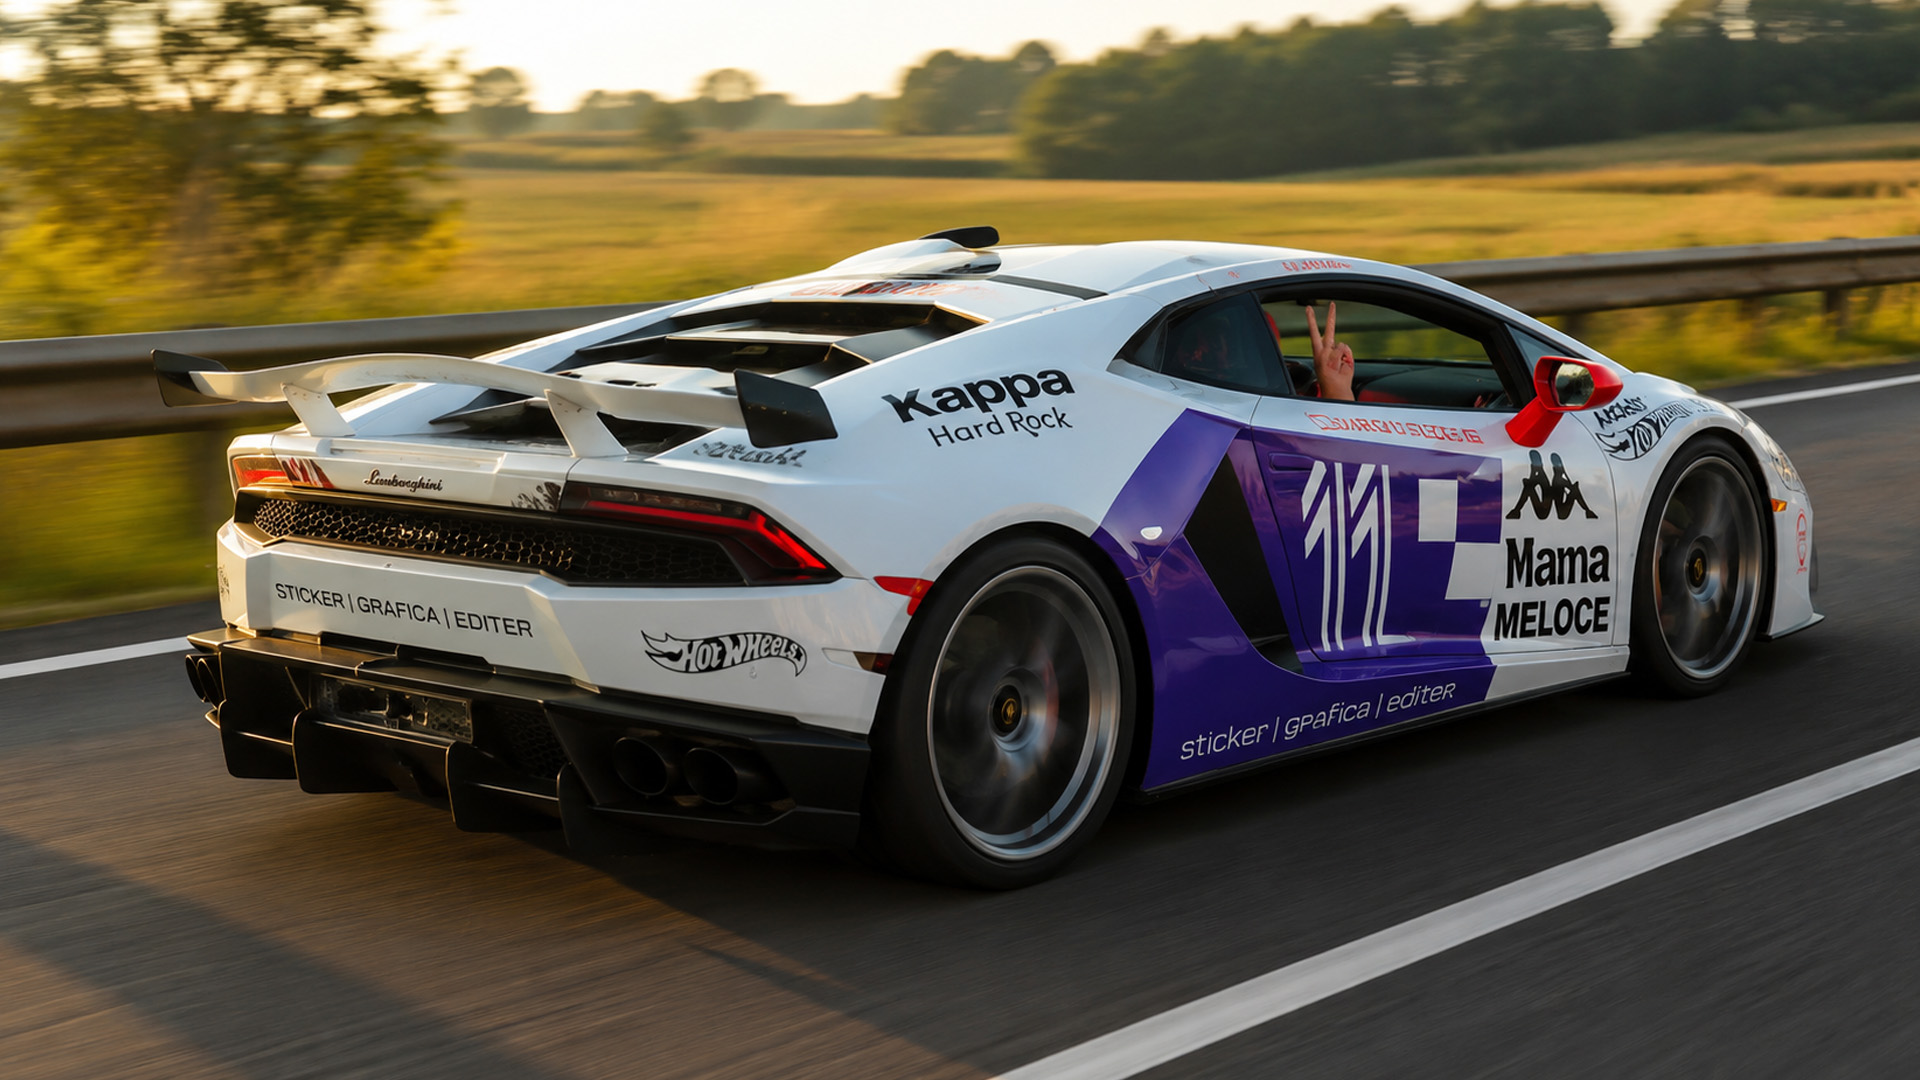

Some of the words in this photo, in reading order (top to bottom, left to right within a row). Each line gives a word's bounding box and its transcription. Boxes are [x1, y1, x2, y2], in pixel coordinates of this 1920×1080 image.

[881, 369, 1076, 423] Kappa
[928, 414, 1005, 447] Hard
[1005, 407, 1073, 437] Rock
[1505, 537, 1610, 588] Mama
[275, 583, 345, 609] STICKER
[357, 596, 441, 625] GRAFICA
[454, 611, 534, 638] EDITER
[1494, 596, 1611, 641] MELOCE
[1180, 726, 1269, 760] sticker
